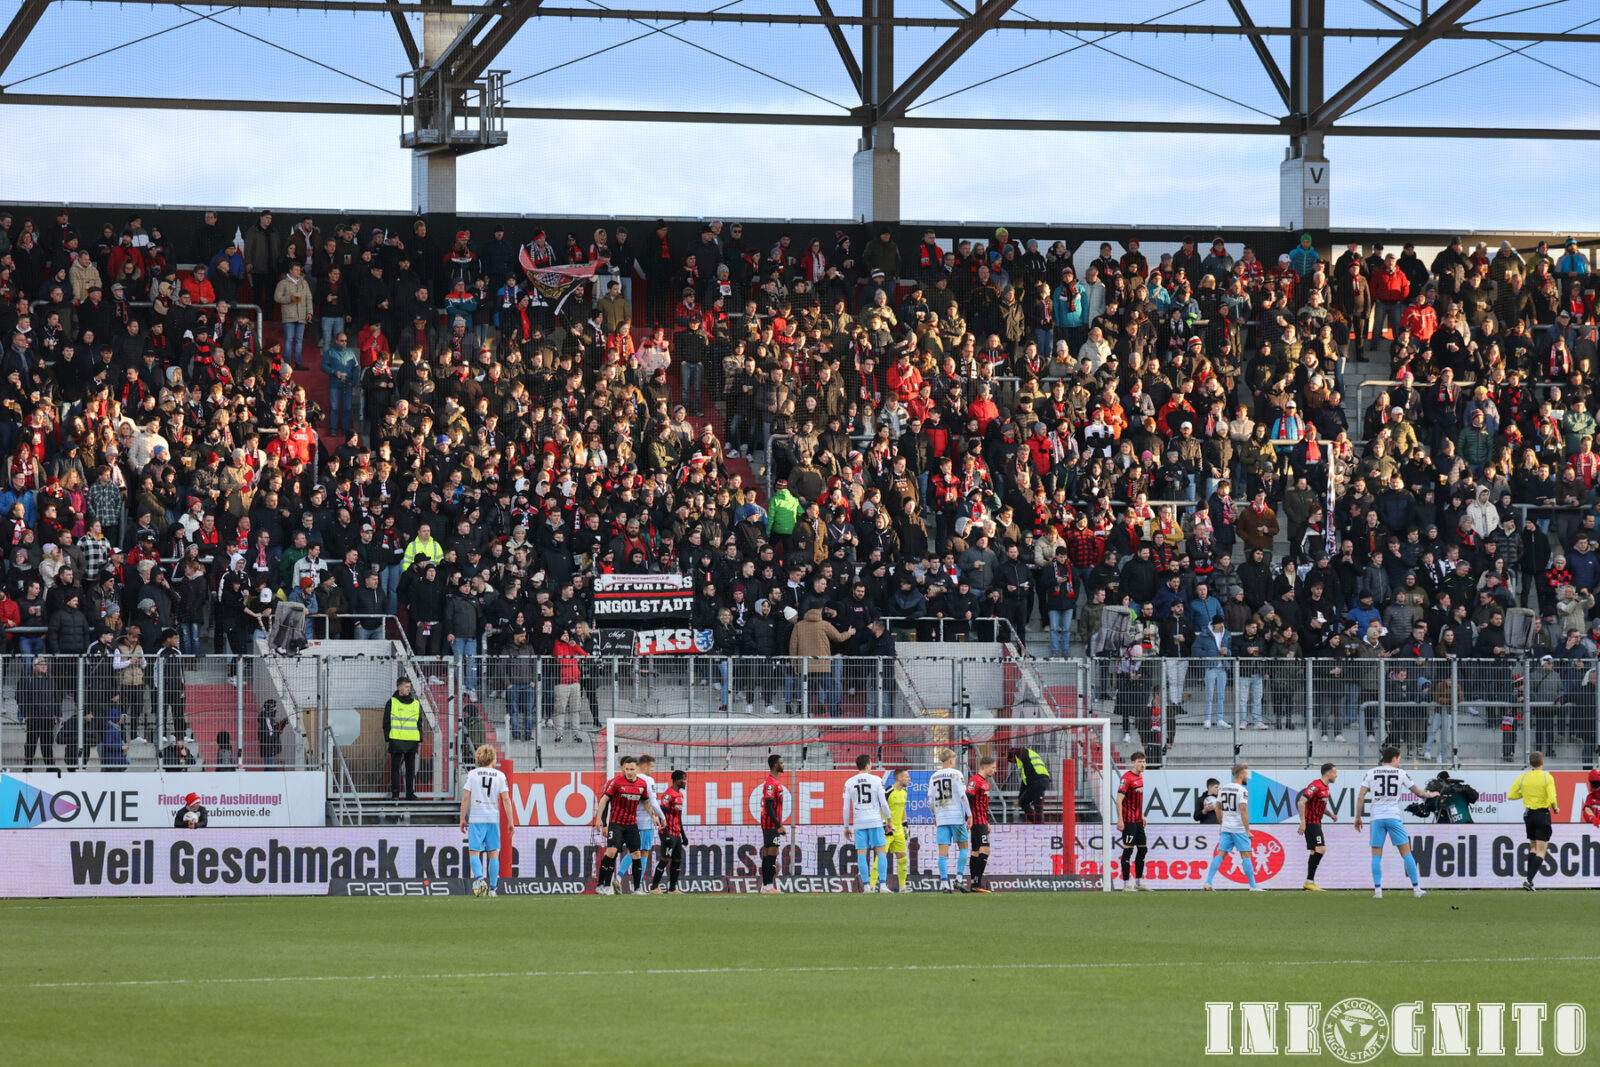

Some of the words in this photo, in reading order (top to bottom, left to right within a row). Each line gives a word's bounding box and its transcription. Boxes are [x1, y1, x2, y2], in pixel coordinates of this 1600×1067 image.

[1310, 167, 1324, 184] V
[594, 597, 693, 614] INGOLSTADT
[637, 628, 692, 654] FKS
[482, 776, 492, 798] 4
[853, 784, 872, 804] 15
[933, 779, 952, 801] 39
[1374, 775, 1398, 797] 36
[13, 790, 138, 823] MOVIE
[220, 794, 282, 806] Ausbildung!
[1221, 793, 1237, 811] 20
[1050, 836, 1208, 850] BACKAUS
[1126, 834, 1135, 844] 17
[1316, 836, 1322, 844] 9
[666, 847, 673, 856] 14
[1405, 835, 1477, 877] Weil
[71, 840, 154, 885] Weil
[170, 839, 400, 884] Geschmack
[416, 839, 519, 878] kei
[503, 881, 585, 894] luitGUARD
[730, 877, 855, 893] TEMGEIST
